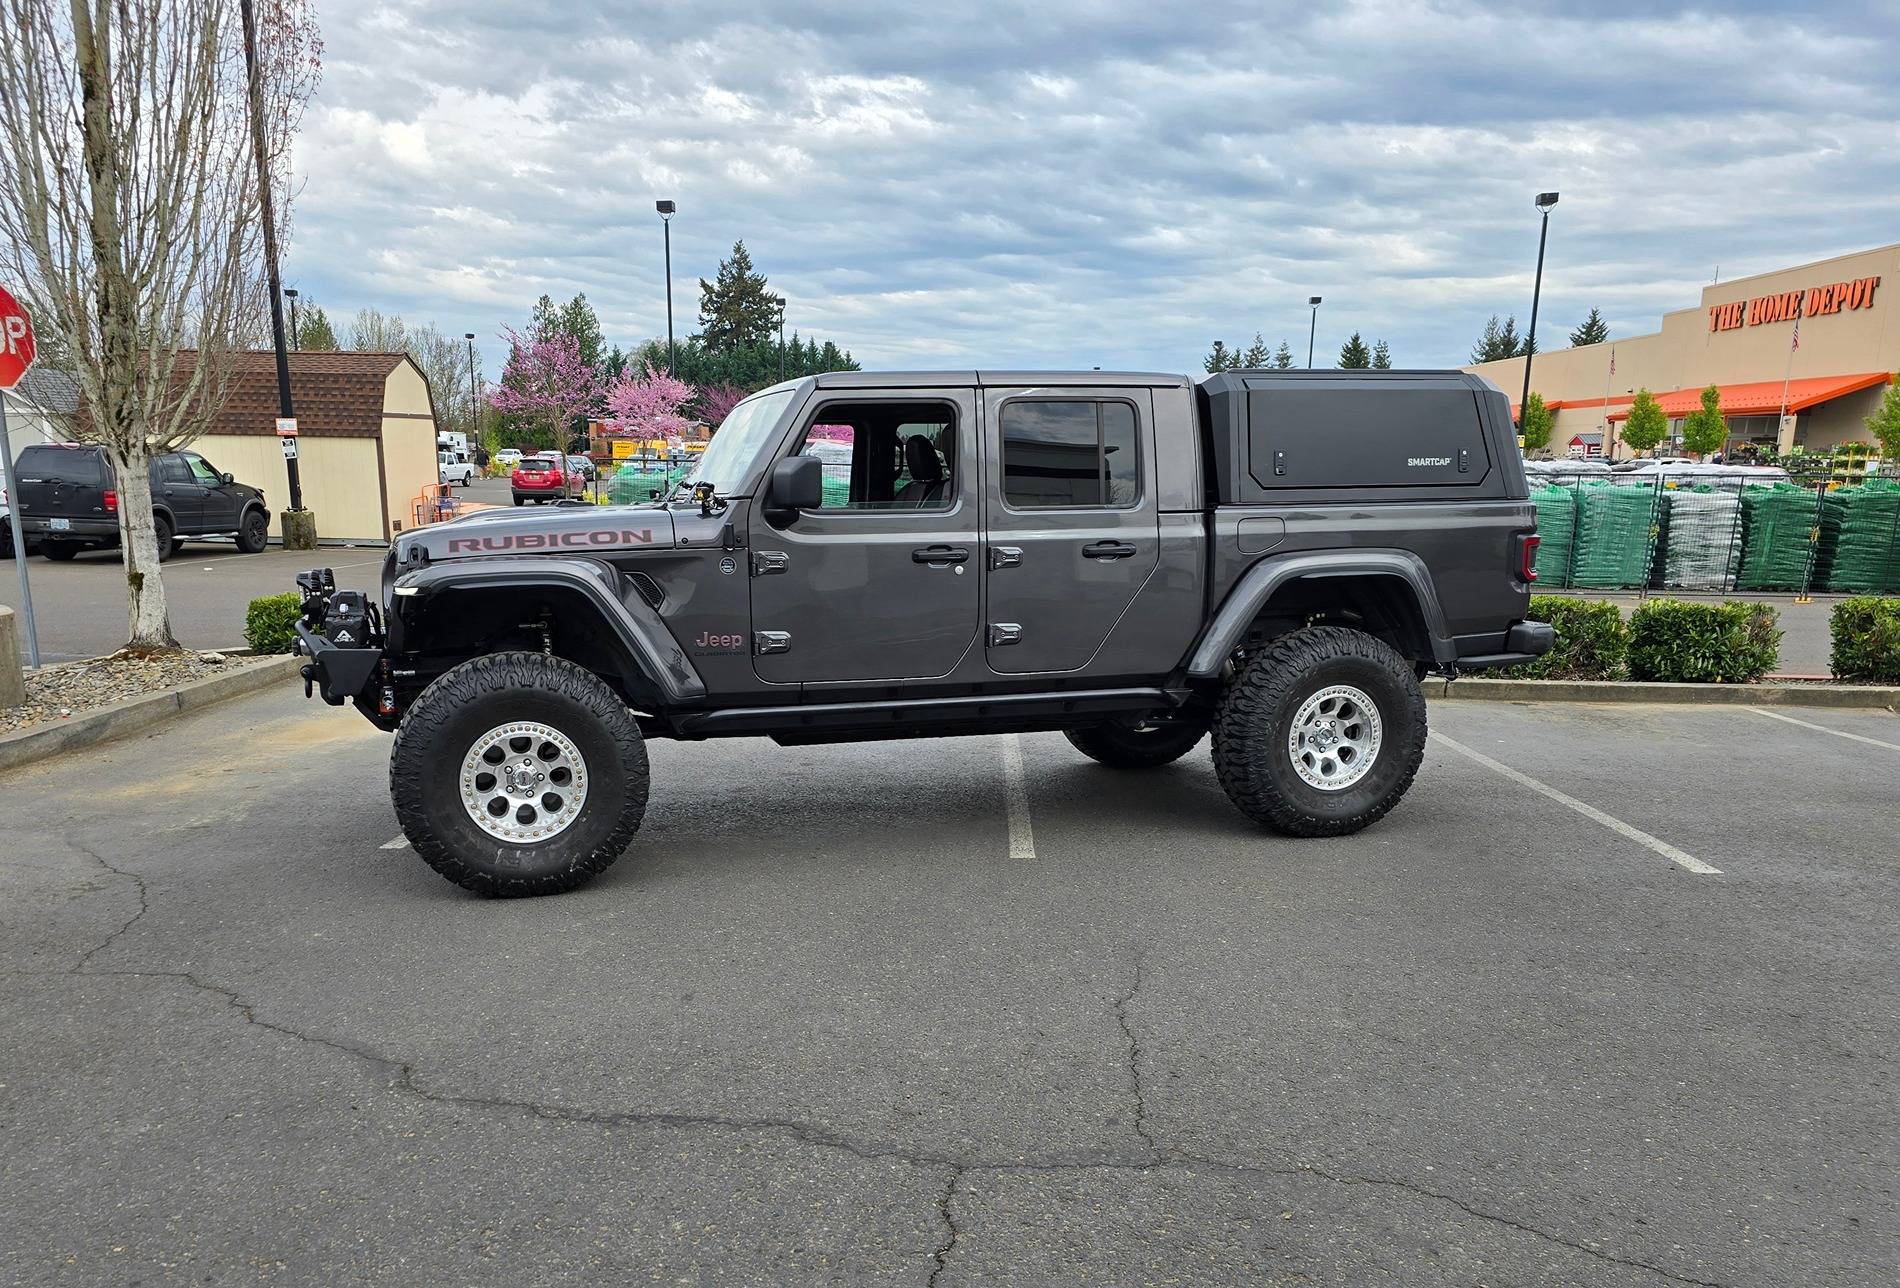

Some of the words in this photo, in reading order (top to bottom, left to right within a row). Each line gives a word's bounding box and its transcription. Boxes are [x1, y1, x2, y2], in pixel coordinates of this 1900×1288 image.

[1709, 300, 1746, 332] THE
[1748, 290, 1805, 326] HOME
[1803, 276, 1881, 318] DEPOT
[1407, 457, 1451, 466] SMARTCAP
[448, 529, 653, 553] RUBICON
[695, 631, 742, 650] Jeep
